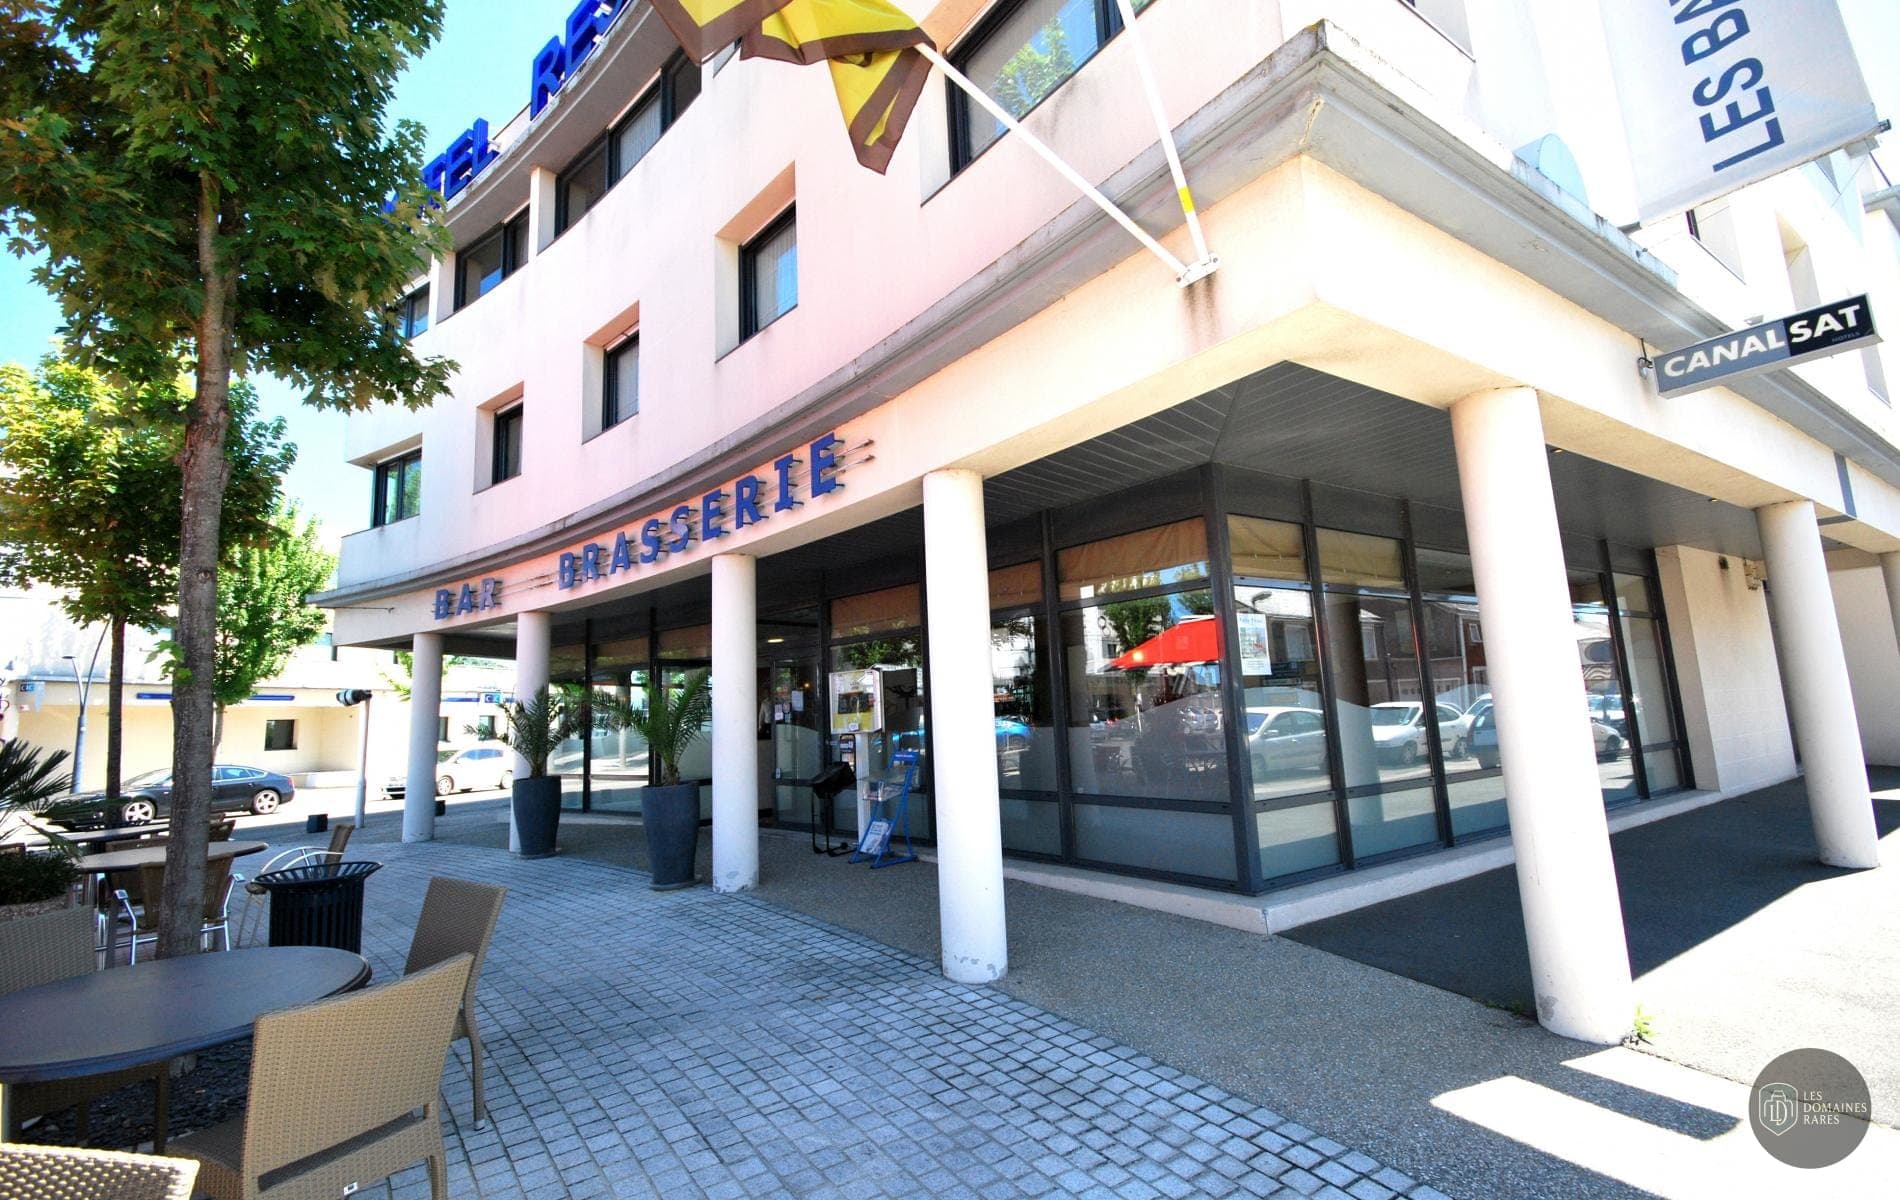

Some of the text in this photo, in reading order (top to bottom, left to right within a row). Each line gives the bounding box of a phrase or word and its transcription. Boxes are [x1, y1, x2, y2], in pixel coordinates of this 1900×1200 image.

[1669, 0, 1785, 172] LES BA
[435, 432, 837, 620] BAR BRASSERIE
